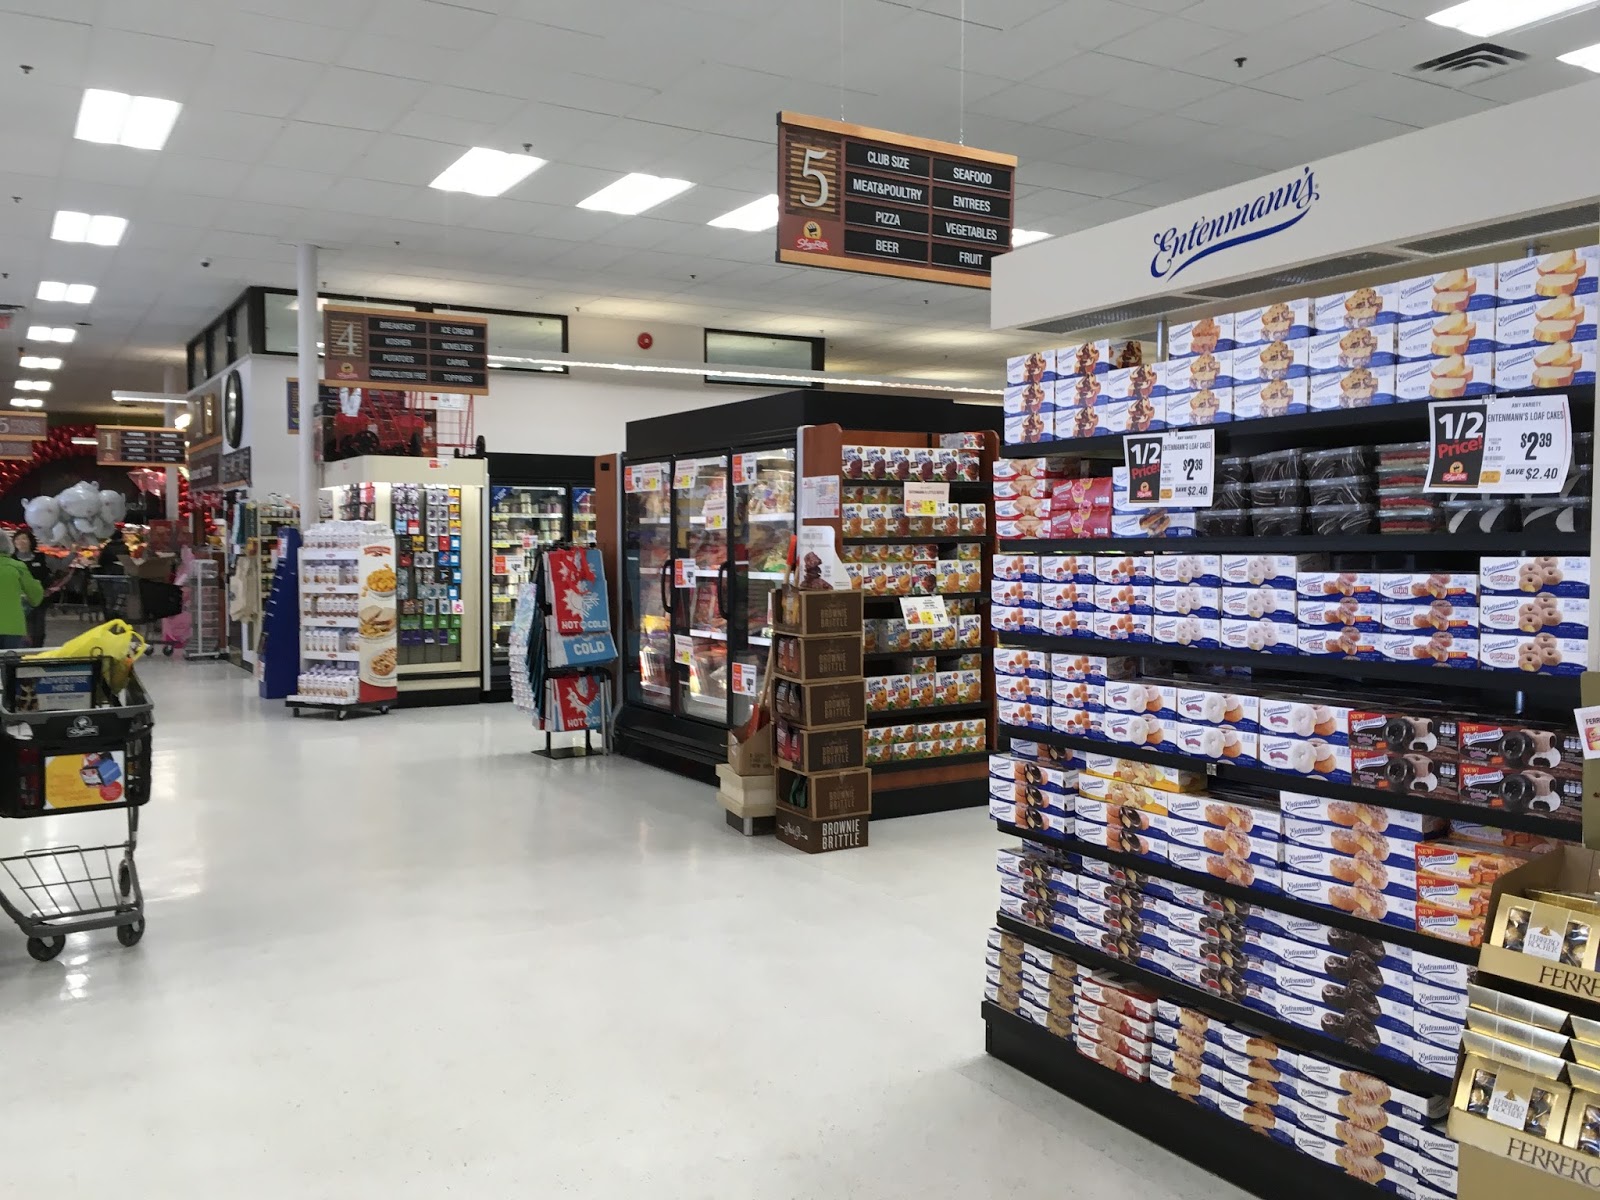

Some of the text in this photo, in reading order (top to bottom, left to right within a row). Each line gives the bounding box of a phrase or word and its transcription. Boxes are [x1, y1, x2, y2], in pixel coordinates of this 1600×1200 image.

[868, 152, 909, 170] CLUB SIZE
[800, 149, 828, 207] 5
[954, 168, 991, 184] SEAFOOD
[854, 179, 922, 200] MEAT&POULTRY
[954, 196, 990, 212] ENTREES
[876, 212, 900, 225] PIZZA
[1150, 166, 1320, 279] Entenmann's
[946, 223, 997, 240] VEGETABLES
[876, 240, 899, 253] BEER
[960, 252, 982, 265] FRUIT
[380, 322, 416, 331] BREAKFAST
[452, 328, 474, 336] CREAM
[337, 323, 358, 355] 4
[385, 338, 411, 346] KOSHER
[442, 343, 473, 351] NOVELTIES
[383, 355, 414, 363] POTATOES
[444, 374, 473, 382] TOPPINGS
[1488, 411, 1564, 423] ENTENMANN'S LOAF CAKES
[1438, 412, 1484, 440] 1/2
[1163, 443, 1188, 451] ENTENMANN'S
[1438, 435, 1483, 458] Price!
[1130, 443, 1161, 465] 1/2
[1131, 461, 1160, 479] Price!
[1526, 468, 1558, 480] $2.40
[1188, 486, 1207, 496] $2.40
[562, 620, 607, 630] HOT COLD
[574, 641, 605, 655] COLD
[40, 676, 87, 684] ADVERTISE
[567, 719, 584, 728] HOT
[822, 819, 860, 836] BROWNIE
[822, 832, 860, 850] BRITTLE
[1529, 934, 1560, 946] FERRERO
[1527, 941, 1558, 953] ROCHER
[1495, 1097, 1525, 1113] FERRERO
[1492, 1105, 1523, 1120] ROCHER
